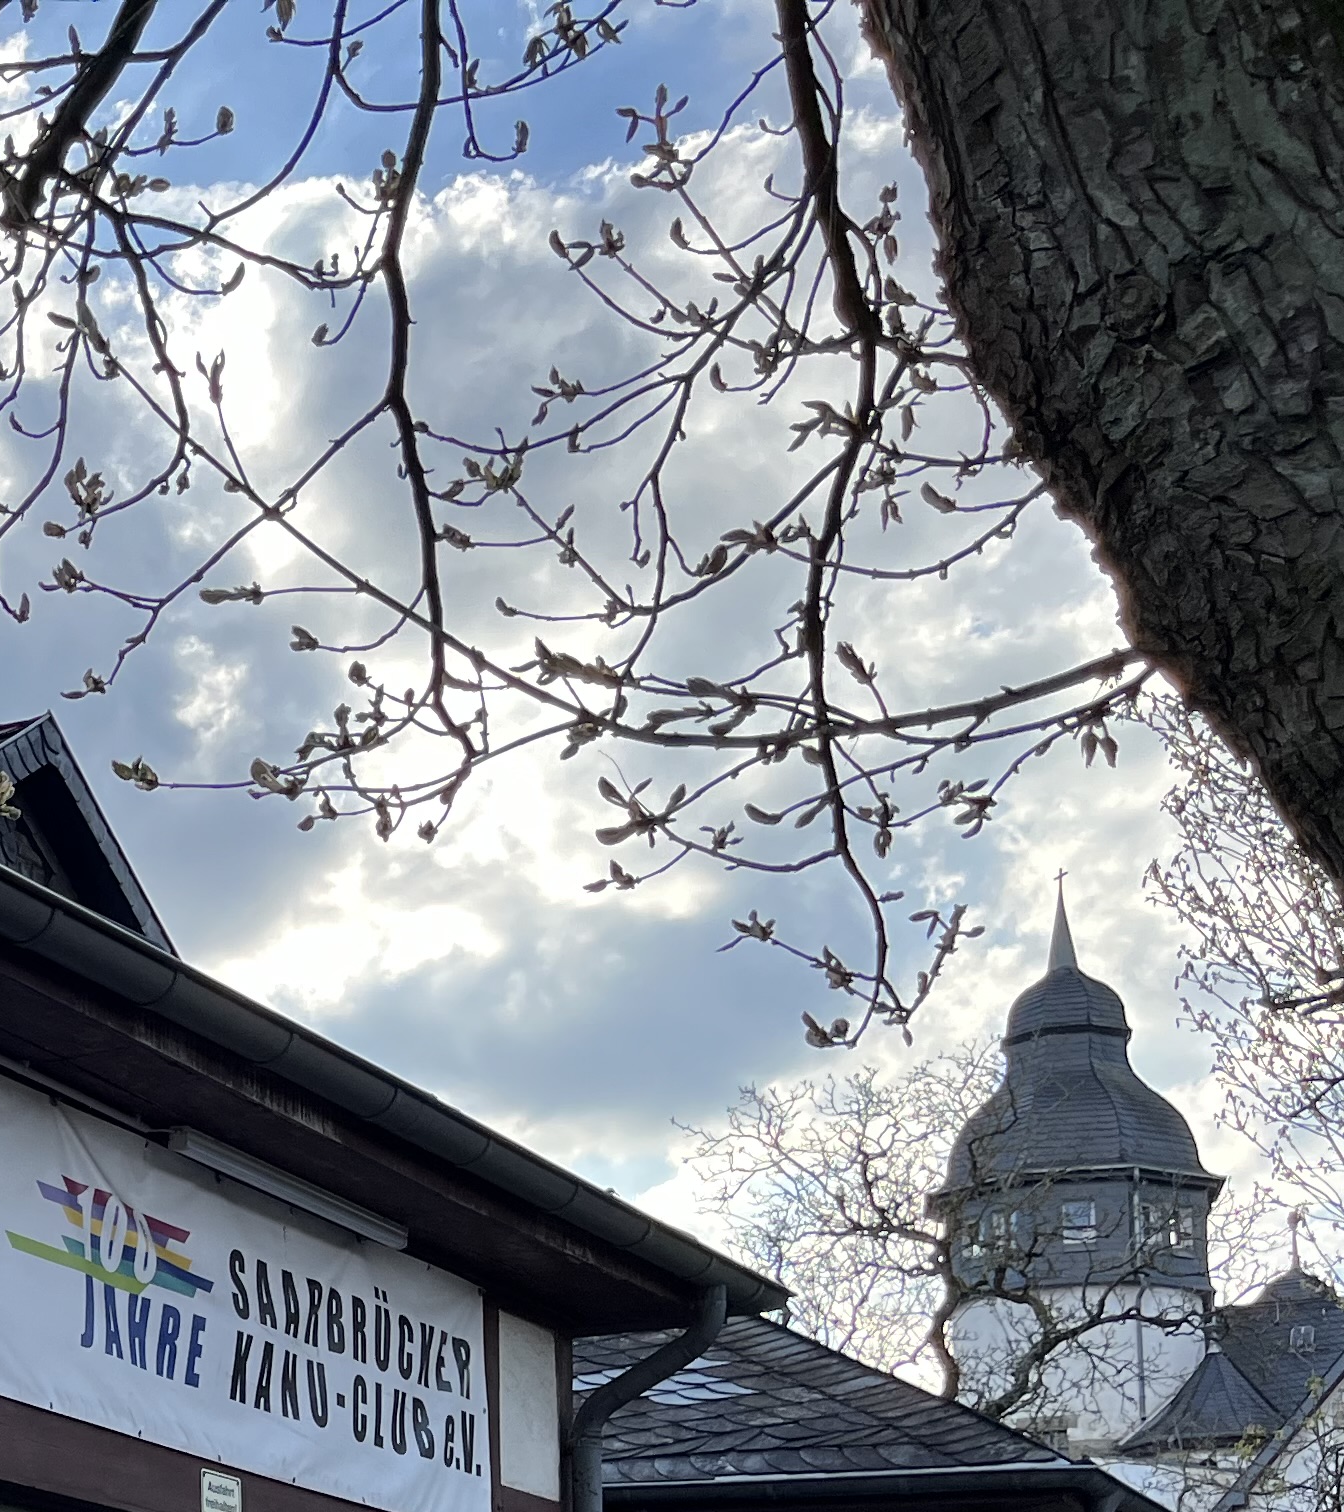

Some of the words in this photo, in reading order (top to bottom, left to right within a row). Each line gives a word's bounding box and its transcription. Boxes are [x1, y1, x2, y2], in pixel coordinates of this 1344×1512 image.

[77, 1188, 158, 1284] 100
[79, 1274, 207, 1388] JAHRE
[228, 1249, 472, 1398] SAARBRÜCKER
[230, 1330, 434, 1461] KANU-CLUB
[442, 1411, 482, 1477] e.V.
[208, 1481, 235, 1498] Ausfahrt
